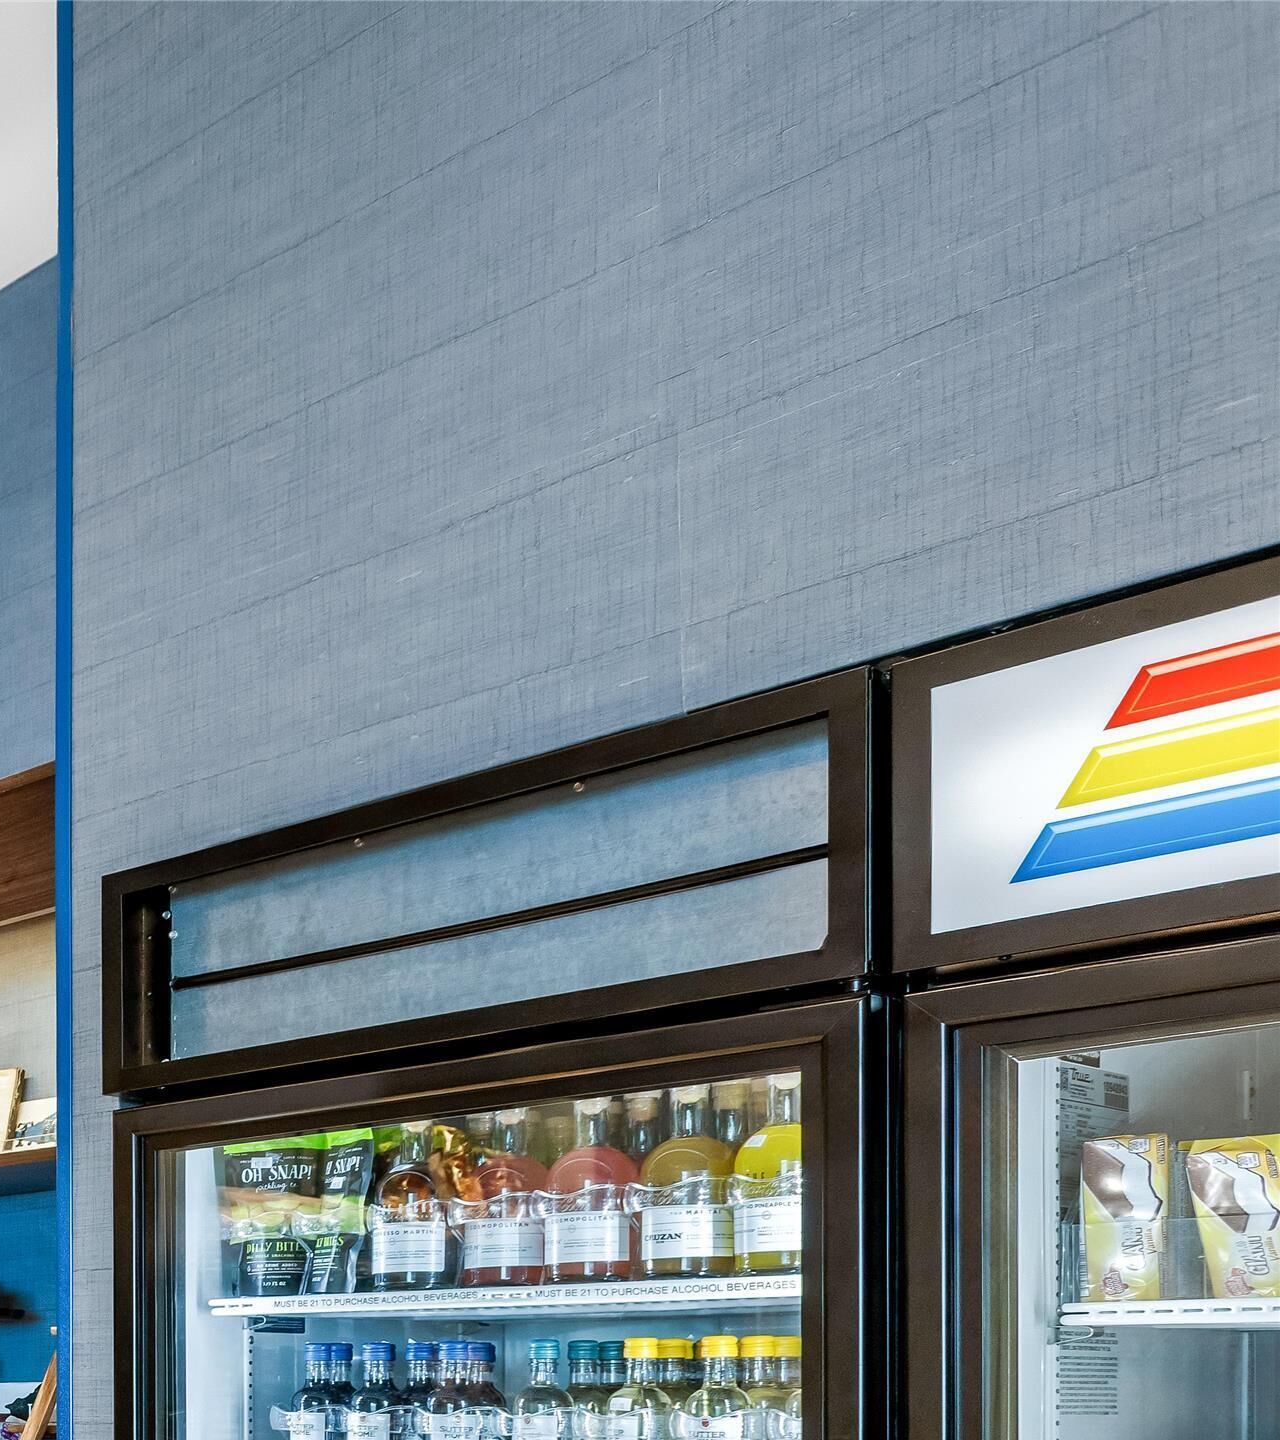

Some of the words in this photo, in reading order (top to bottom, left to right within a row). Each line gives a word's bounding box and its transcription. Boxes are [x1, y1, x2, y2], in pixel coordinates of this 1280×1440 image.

[241, 1168, 263, 1184] OH
[270, 1164, 313, 1182] SNAP!
[644, 1232, 683, 1244] CRUZAN
[534, 1288, 562, 1298] MUST
[563, 1288, 579, 1297] BE
[580, 1288, 592, 1296] 21
[594, 1287, 609, 1296] TO
[610, 1284, 668, 1296] PURCHASE
[670, 1282, 723, 1294] ALCOHOL
[725, 1279, 798, 1291] BEVERAGES
[273, 1301, 296, 1309] MUST
[297, 1300, 309, 1308] BE
[310, 1299, 319, 1307] 21
[321, 1299, 332, 1307] TO
[333, 1296, 380, 1306] PURCHASE
[381, 1294, 422, 1304] ALCOHOL
[423, 1290, 479, 1301] BEVERAGES
[439, 1425, 476, 1435] SUTTER
